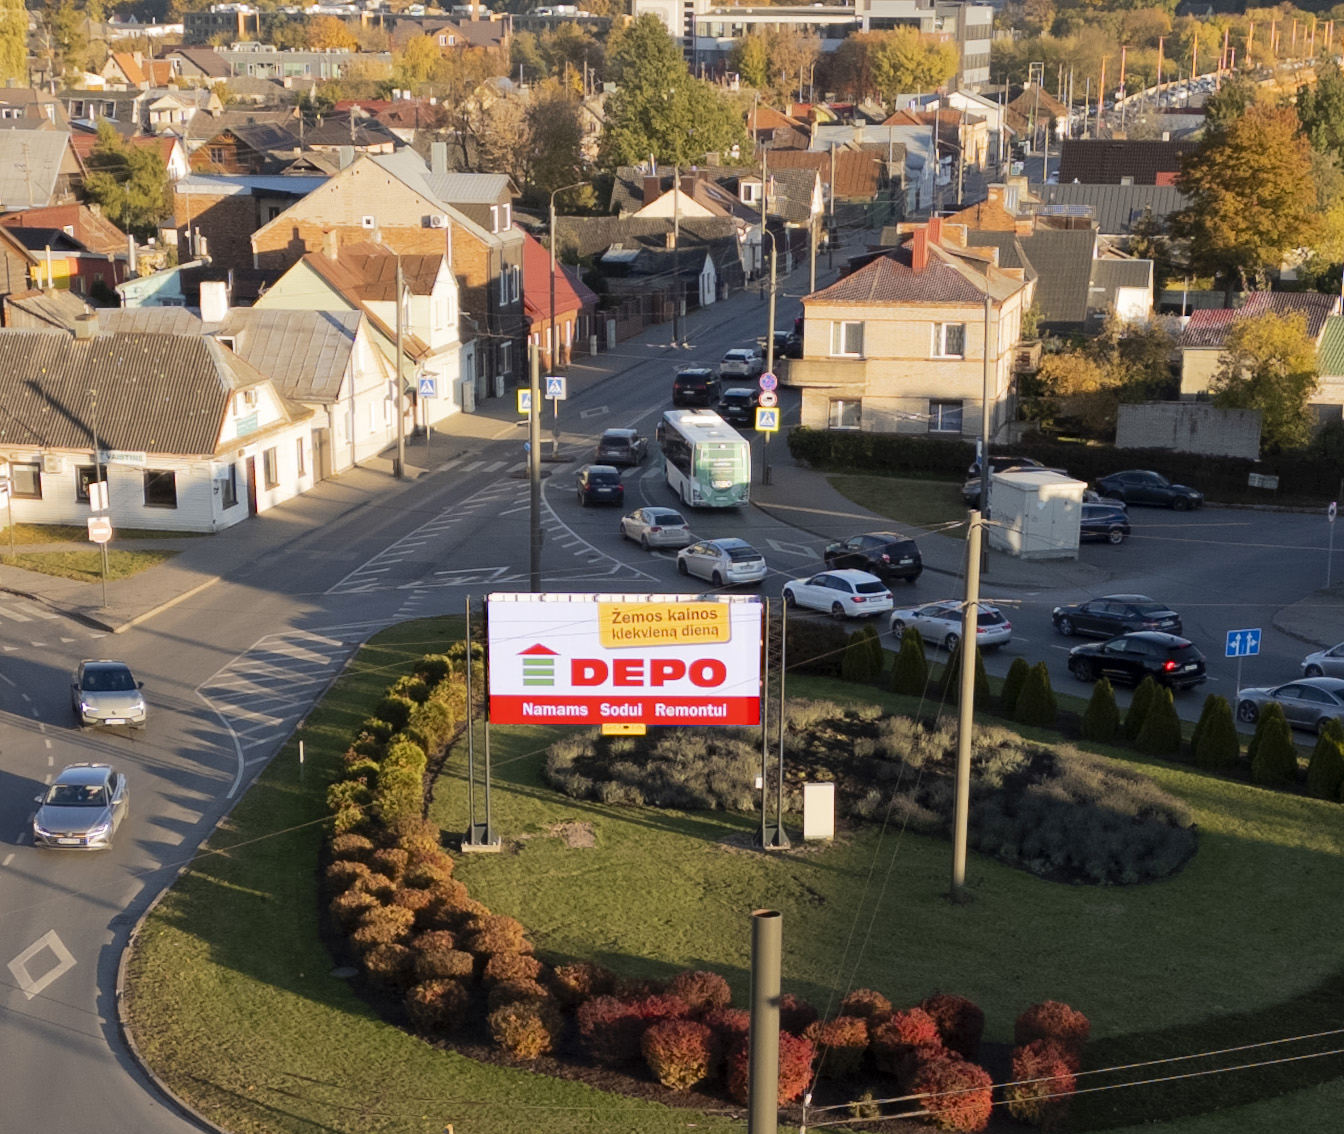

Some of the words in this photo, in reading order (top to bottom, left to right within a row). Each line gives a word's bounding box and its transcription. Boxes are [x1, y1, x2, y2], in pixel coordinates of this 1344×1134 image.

[612, 607, 662, 624] Žemos
[667, 607, 718, 622] kainos
[612, 626, 678, 640] kiekvieną
[681, 624, 719, 638] dieną
[570, 658, 727, 687] DEPO
[522, 702, 589, 716] Namams
[600, 702, 643, 717] Sodui
[655, 702, 727, 717] Remontui
